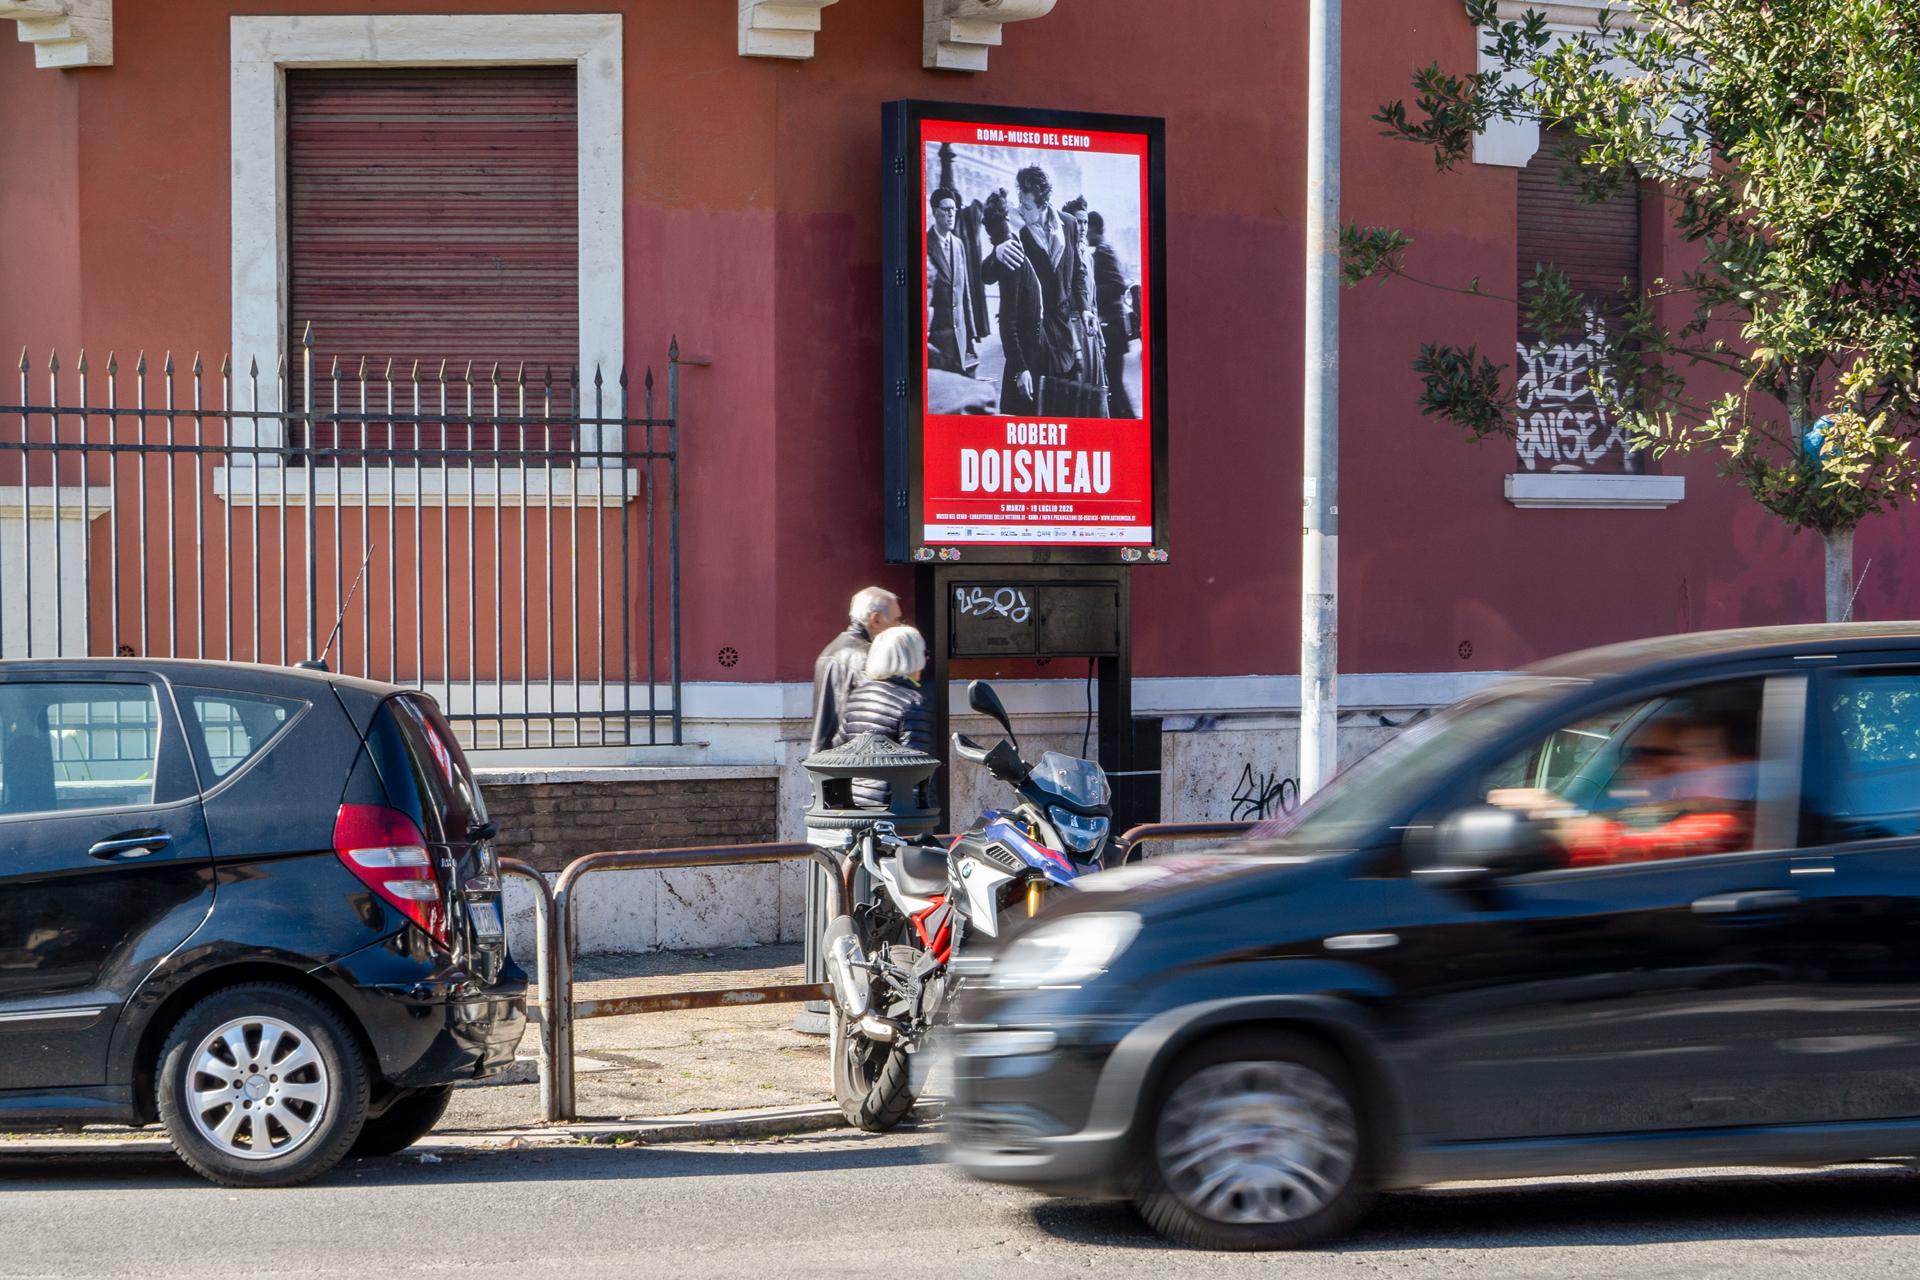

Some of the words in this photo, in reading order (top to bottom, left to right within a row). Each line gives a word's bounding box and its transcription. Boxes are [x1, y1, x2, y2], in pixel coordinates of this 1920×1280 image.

[976, 128, 1040, 144] ROMA-MUSEO
[1043, 133, 1059, 146] DEL
[1061, 135, 1090, 147] GENIO
[1006, 422, 1068, 446] ROBERT
[960, 448, 1111, 494] DOISNEAU
[1000, 504, 1005, 512] 5
[1006, 504, 1025, 512] MARZO
